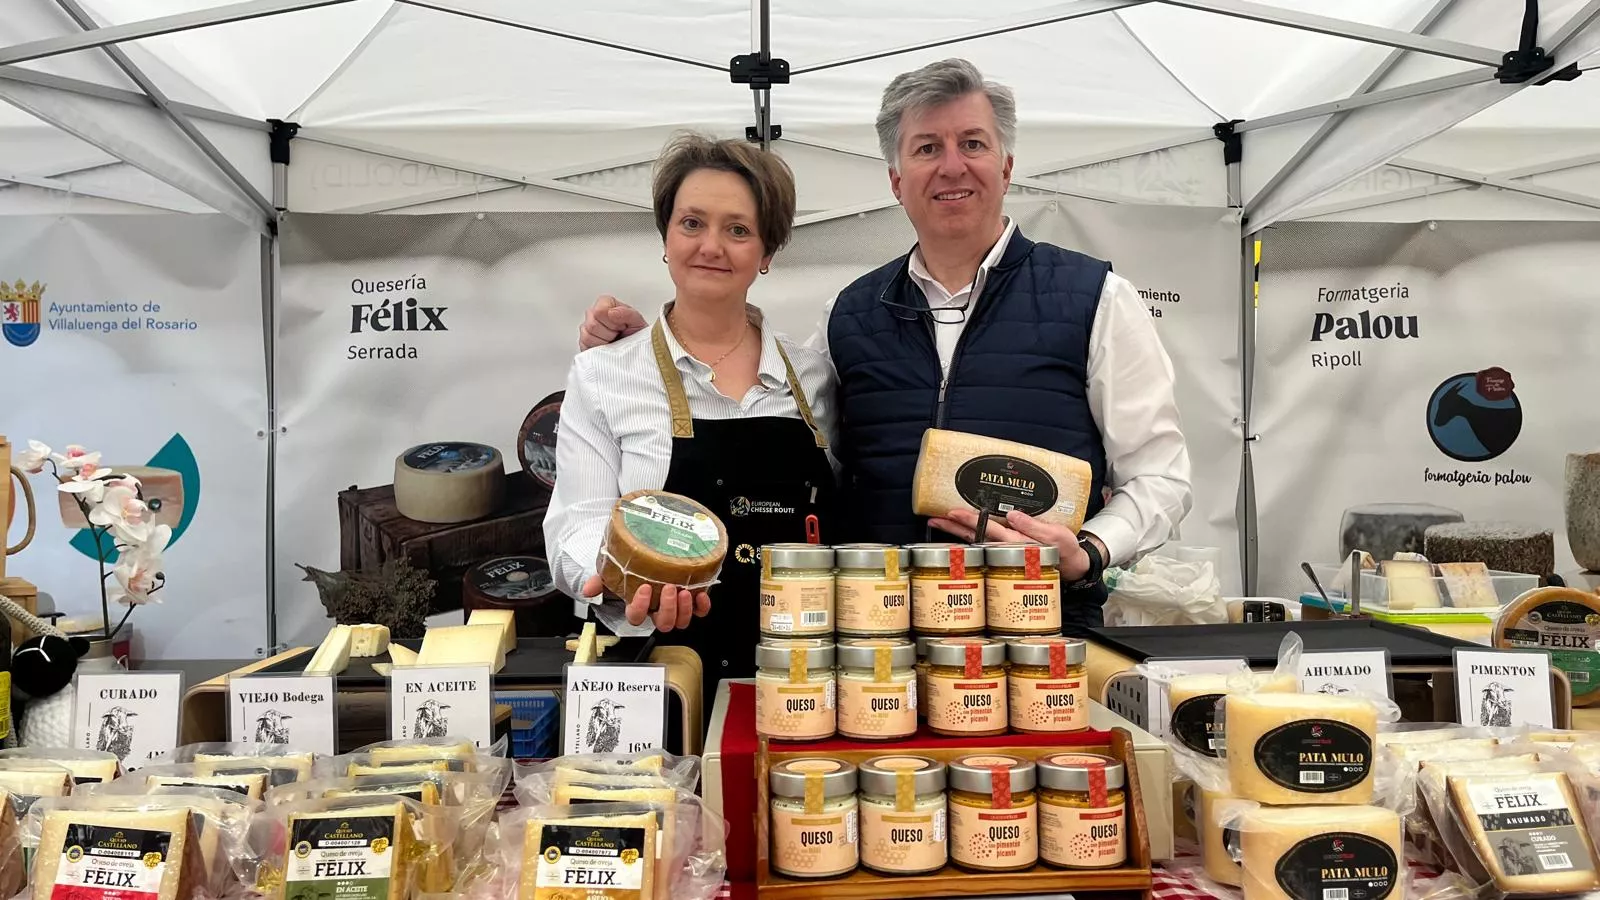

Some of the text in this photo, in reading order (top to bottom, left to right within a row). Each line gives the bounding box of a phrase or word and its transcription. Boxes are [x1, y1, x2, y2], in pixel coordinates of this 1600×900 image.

[351, 275, 427, 295] Quesería
[1317, 282, 1409, 303] Formatgeria
[49, 301, 161, 314] Ayuntamiento de
[350, 298, 449, 333] Félix
[48, 318, 198, 333] Villaluenga del Rosario
[1310, 310, 1419, 341] Palou
[347, 344, 418, 360] Serrada
[1311, 351, 1362, 370] Ripoll
[980, 471, 1004, 484] PATA
[1006, 477, 1035, 490] MULO
[1424, 467, 1531, 487] formatgeria palou
[883, 594, 905, 608] QUESO
[947, 593, 973, 608] QUESO
[1022, 594, 1049, 608] QUESO
[1304, 664, 1371, 677] AHUMADO
[1471, 664, 1536, 676] PIMENTON
[405, 680, 477, 694] EN ACEITE
[571, 678, 661, 692] AÑEJO Reserva
[99, 688, 157, 700] CURADO
[238, 691, 324, 704] VIEJO Bodega
[963, 694, 992, 709] QUESO
[1046, 694, 1074, 709] QUESO
[786, 698, 815, 714] QUESO
[871, 697, 900, 713] QUESO
[628, 742, 652, 753] 16M
[1299, 752, 1364, 762] PATA MULO
[1506, 815, 1546, 825] AHUMADO
[801, 830, 833, 847] QUESO
[891, 828, 923, 844] QUESO
[989, 825, 1020, 841] QUESO
[1090, 823, 1118, 841] QUESO
[97, 841, 138, 849] CASTELLANO
[574, 840, 615, 848] CASTELLANO
[1321, 865, 1388, 879] PATA MULO
